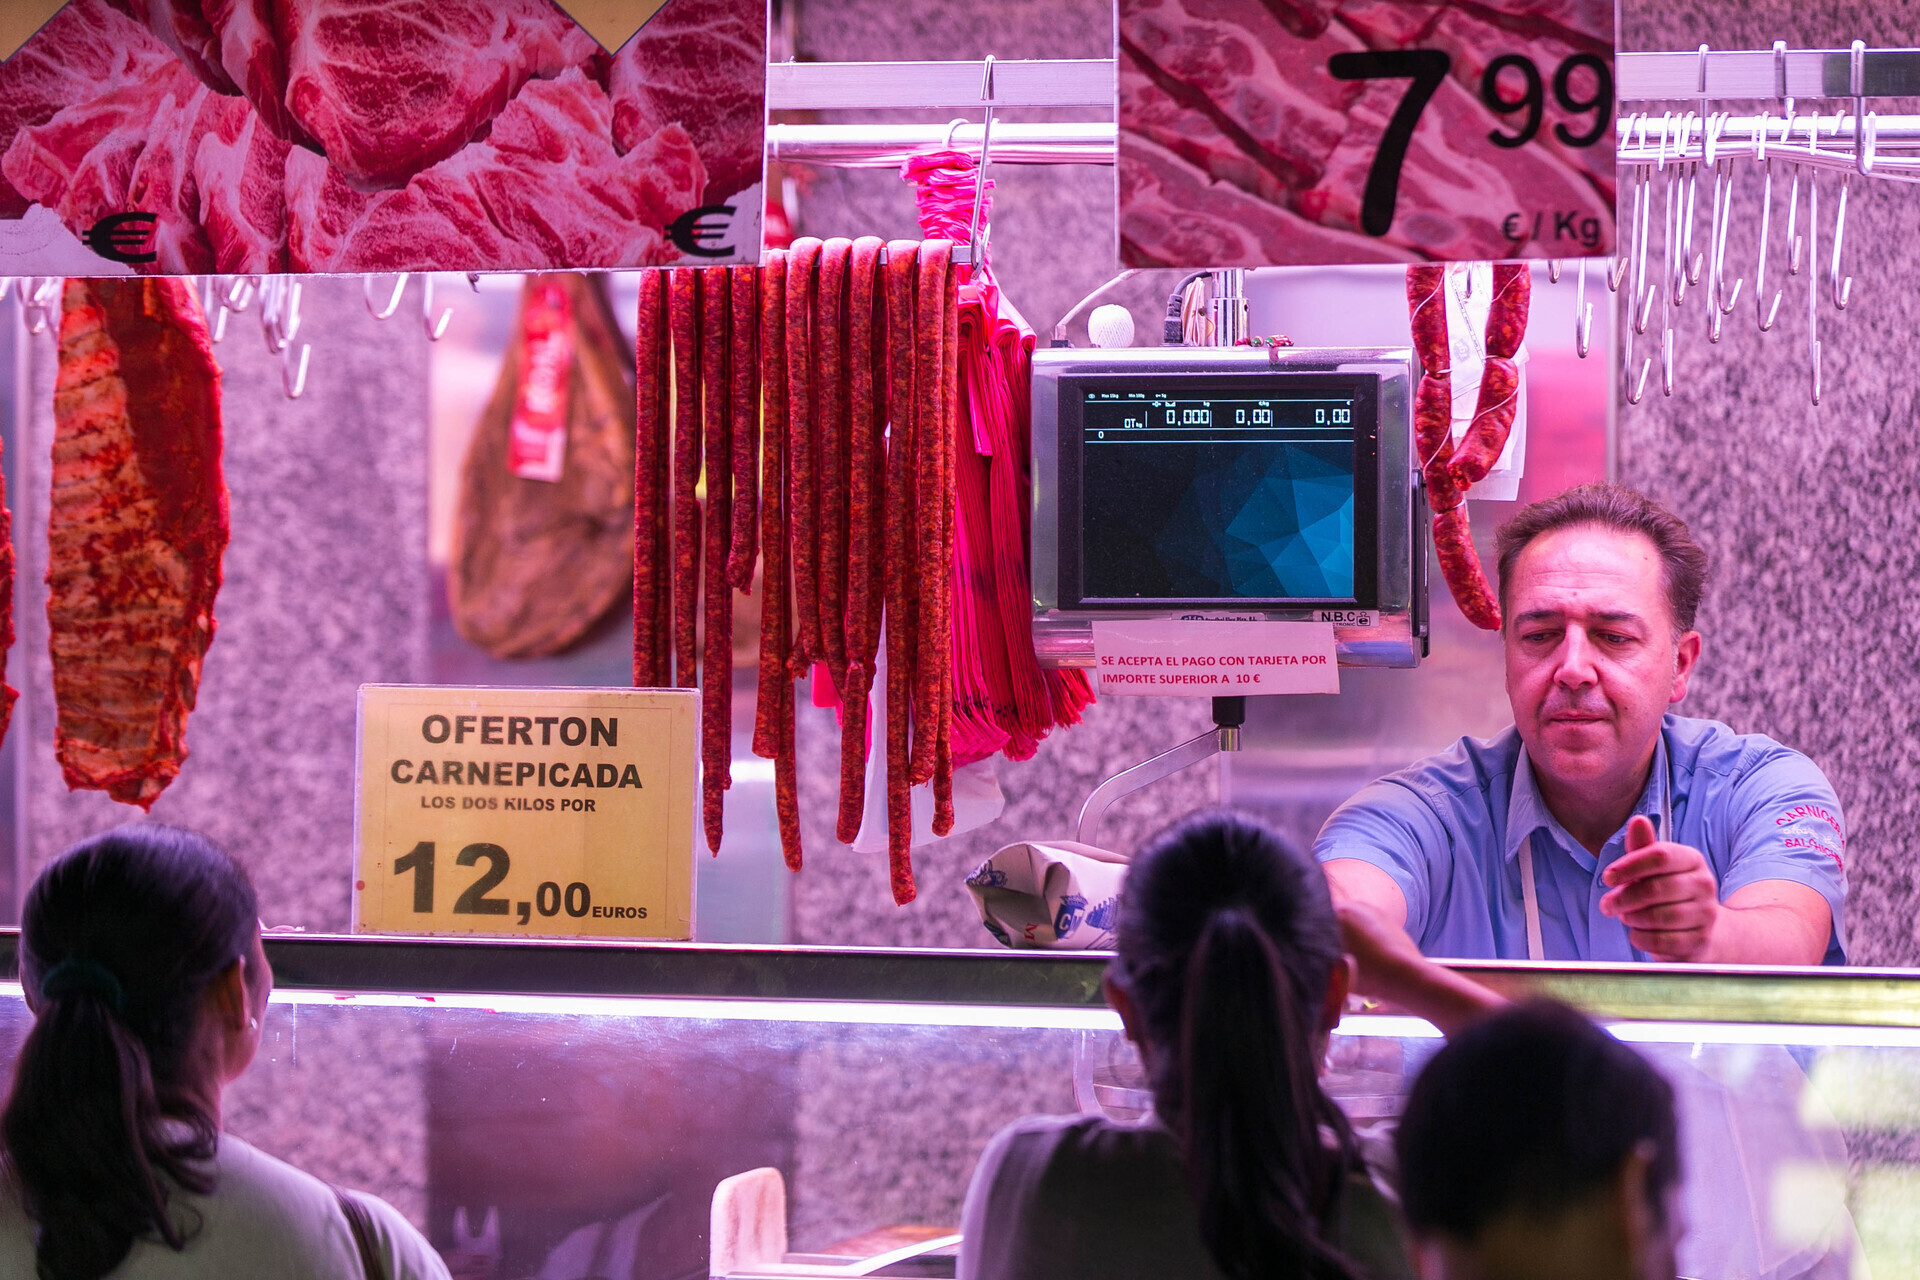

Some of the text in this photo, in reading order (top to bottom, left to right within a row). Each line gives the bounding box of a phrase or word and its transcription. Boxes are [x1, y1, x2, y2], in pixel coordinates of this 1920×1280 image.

[1329, 50, 1613, 237] 7 99
[82, 212, 158, 263] €
[664, 206, 737, 257] €
[1554, 211, 1601, 247] Kg
[1166, 409, 1350, 426] 0,000 0,00 0,00
[1101, 655, 1326, 666] SE ACEPTA EL PAGO CON TARJETA POR
[1102, 673, 1261, 684] IMPORTE SUPERIOR A 10 €
[421, 714, 618, 747] OFERTON
[391, 759, 643, 789] CARNEPICADA
[421, 796, 596, 812] LOS DOS KILOS POR
[394, 841, 648, 926] 12,00 EUROS
